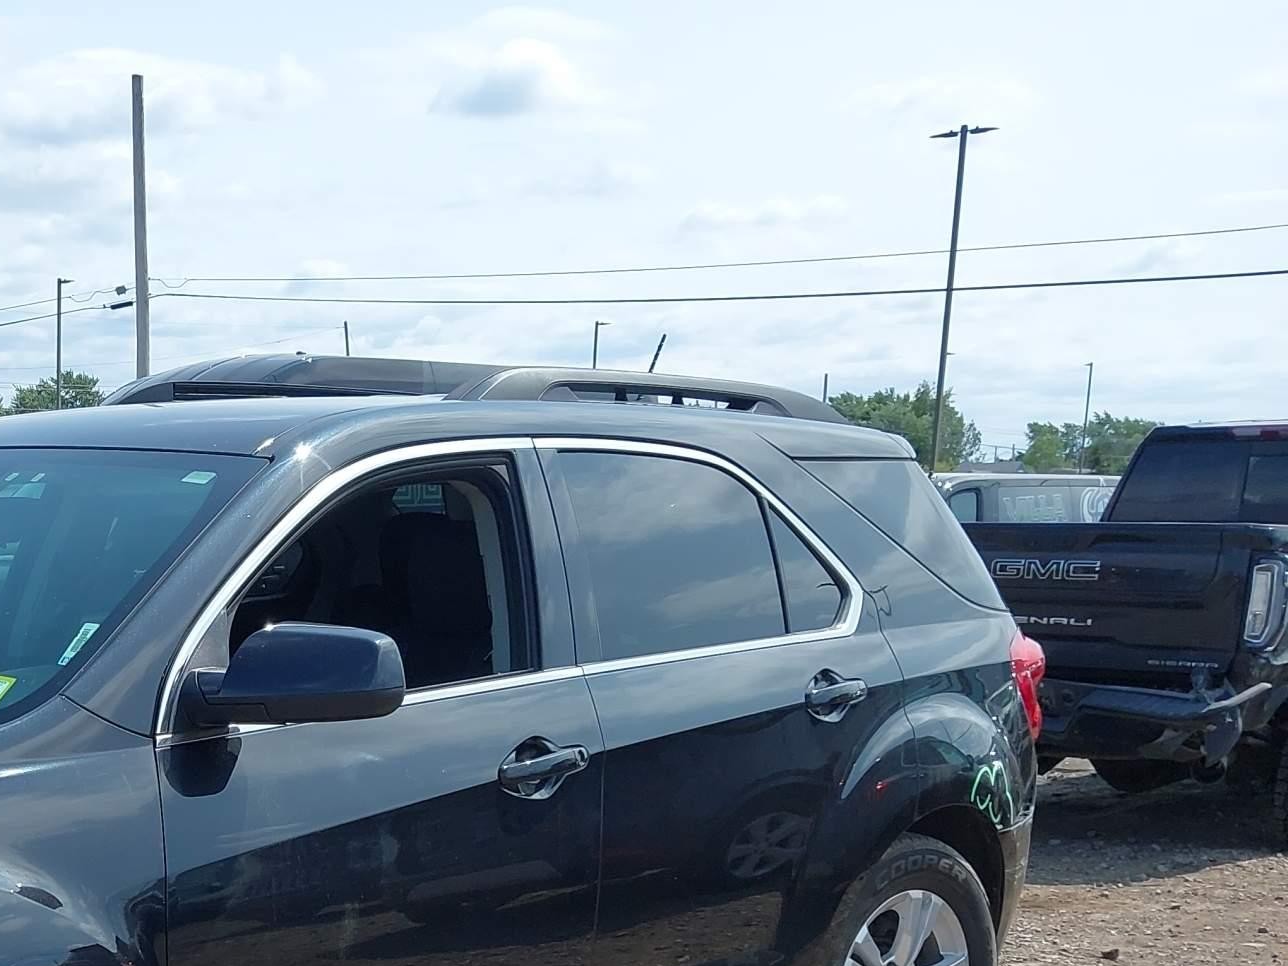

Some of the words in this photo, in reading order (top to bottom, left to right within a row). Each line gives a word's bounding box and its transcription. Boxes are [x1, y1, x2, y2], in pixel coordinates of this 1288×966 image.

[990, 558, 1101, 581] GMC
[1012, 615, 1093, 627] ENALI
[875, 854, 967, 889] COOPER
